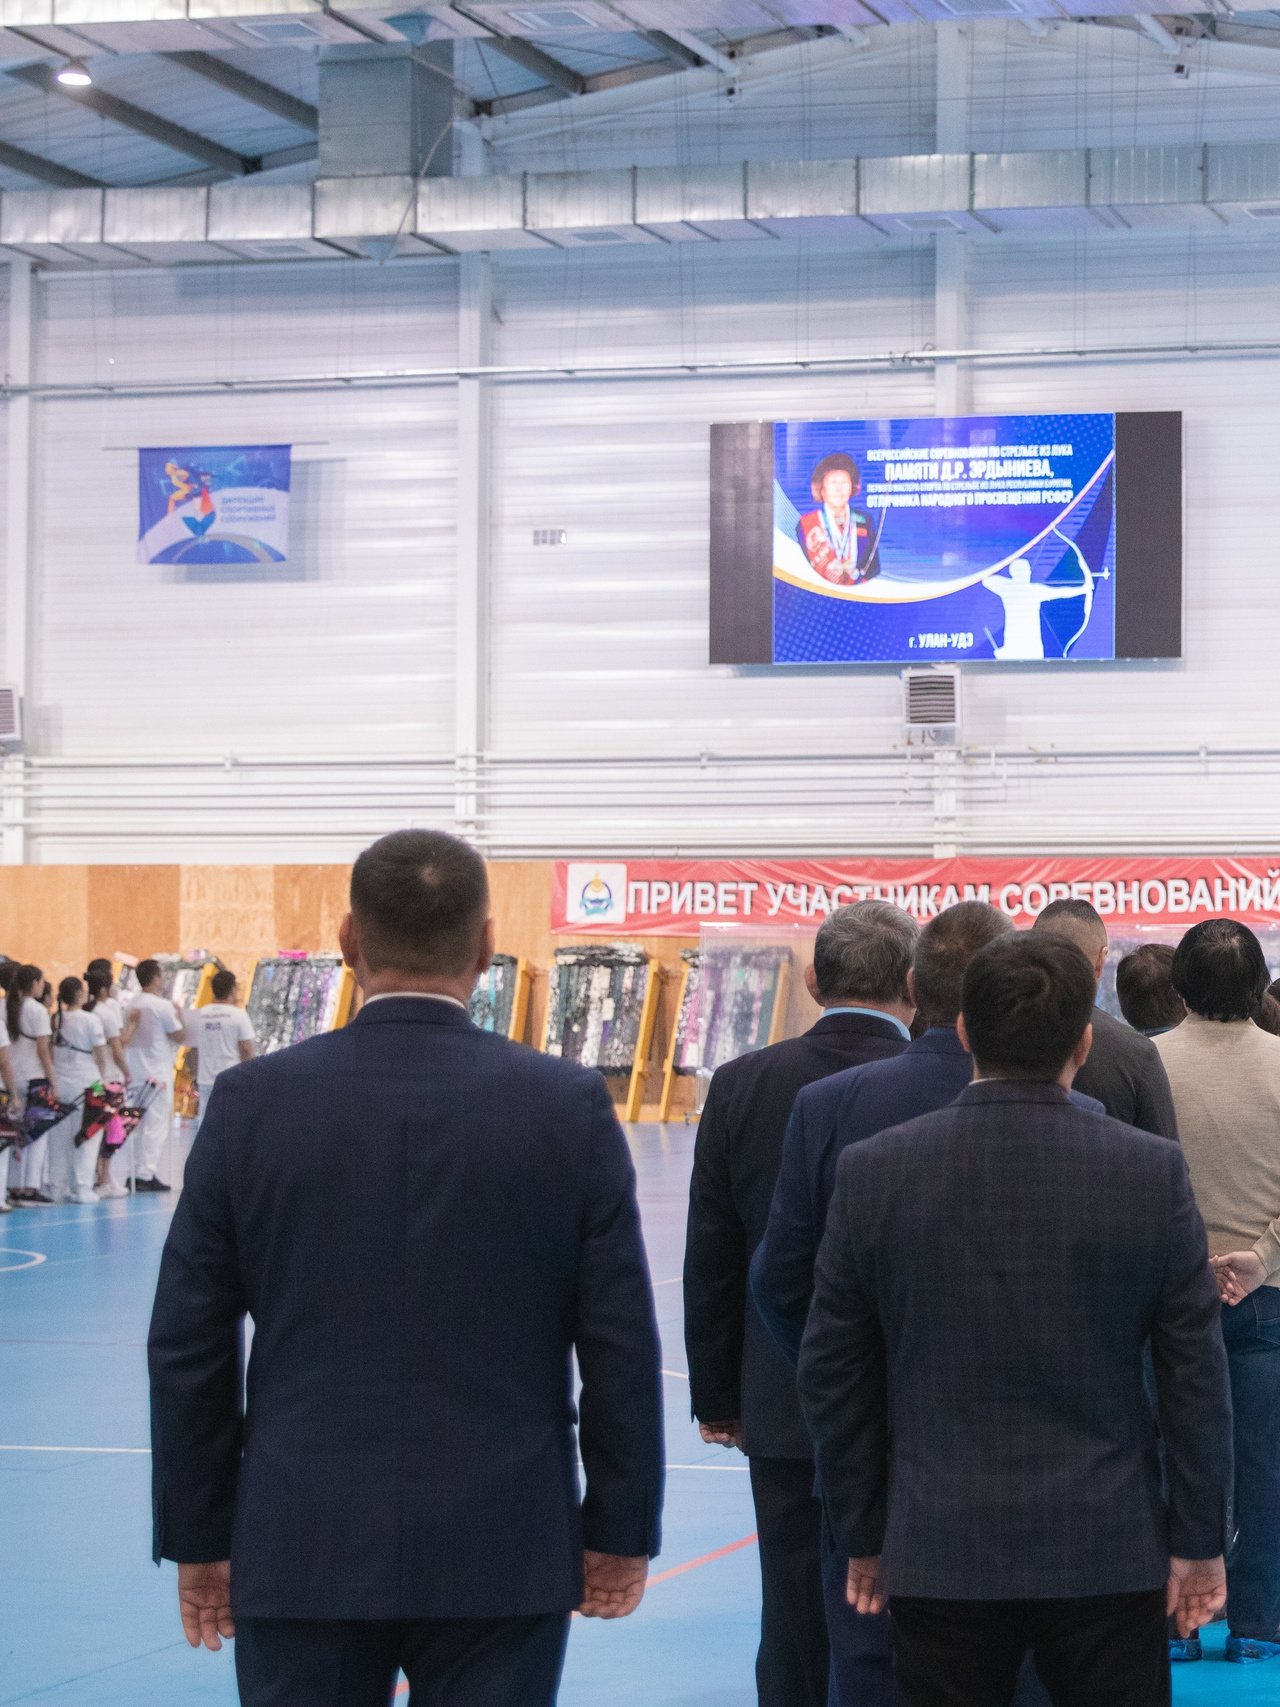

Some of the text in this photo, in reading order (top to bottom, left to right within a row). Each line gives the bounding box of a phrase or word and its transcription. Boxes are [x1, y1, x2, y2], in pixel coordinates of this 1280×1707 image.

[867, 448, 929, 461] ВСЕРОССИЙСКИЕ
[989, 446, 1000, 458] ПО
[1001, 445, 1038, 457] СТРЕЛЬБЕ
[1039, 445, 1050, 456] ИЗ
[1051, 444, 1073, 456] ЛУКА
[885, 459, 1054, 481] ПАМЯТИ Д.Р. ЭРДЫНИЕВА,
[920, 492, 974, 508] НАРОДНОГО
[974, 491, 1041, 506] ПРОСВЕЩЕНИЯ
[1042, 490, 1073, 504] РСФСР
[908, 632, 974, 649] г. УЛАН-УДЭ
[627, 881, 759, 915] ПРИВЕТ
[765, 882, 991, 918] УЧАСТНИКАМ
